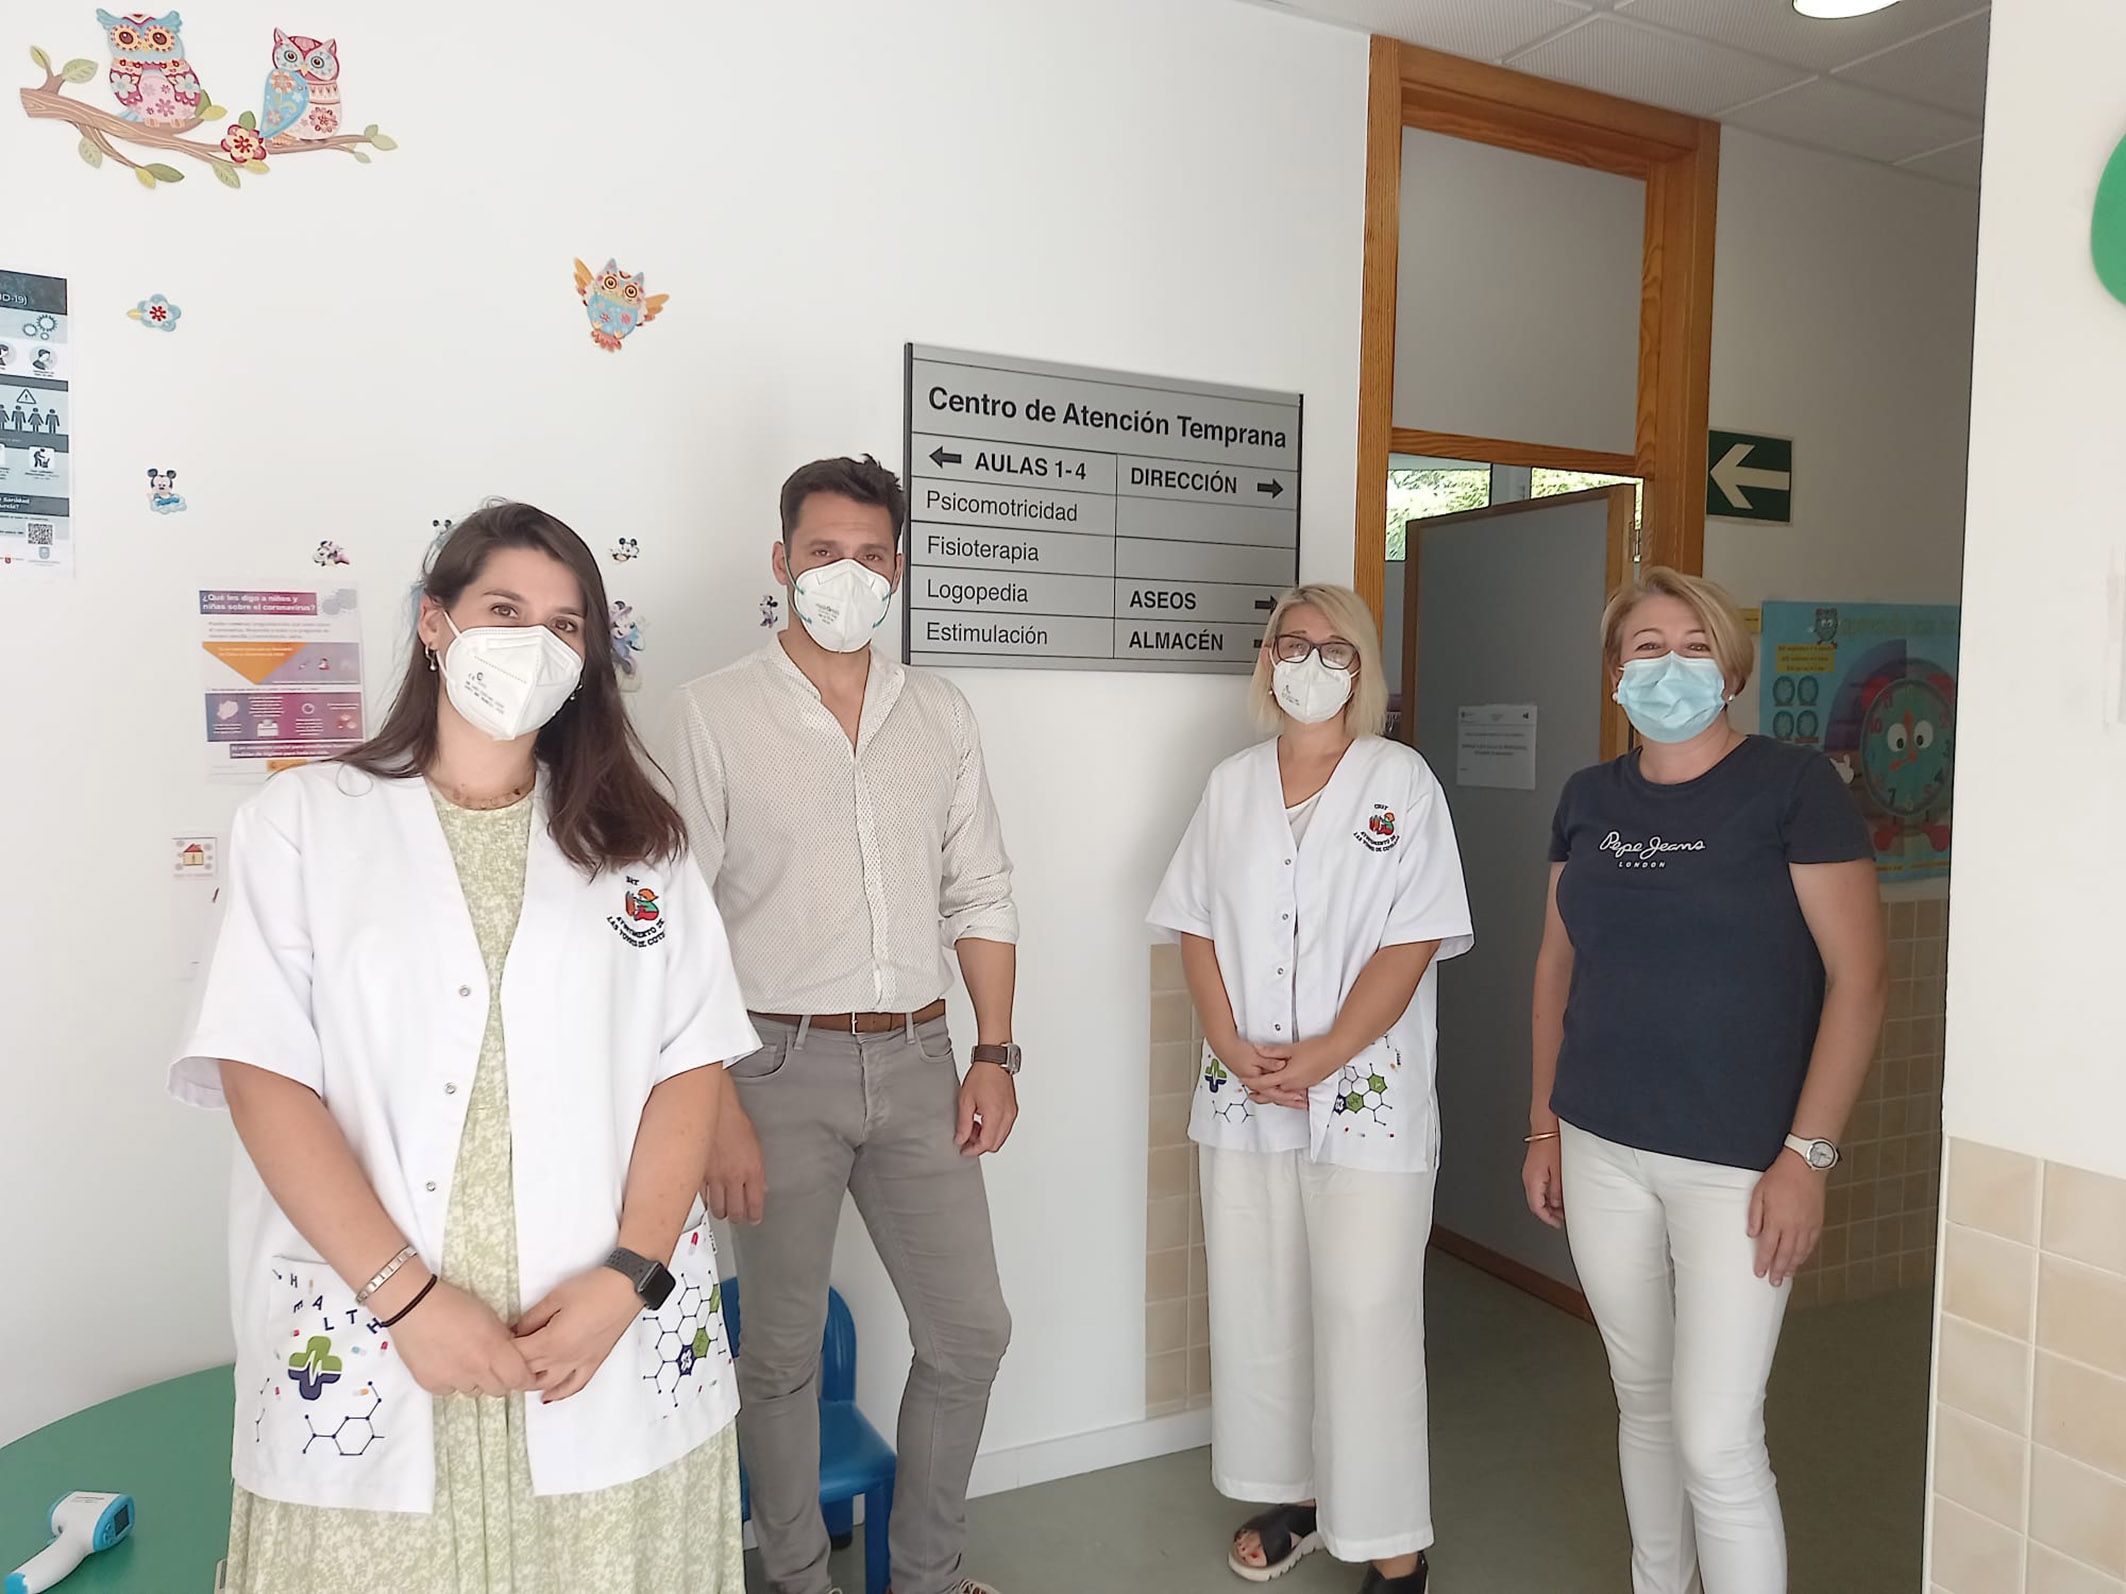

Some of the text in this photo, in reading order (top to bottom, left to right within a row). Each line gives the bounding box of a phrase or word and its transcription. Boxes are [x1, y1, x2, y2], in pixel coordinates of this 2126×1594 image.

[929, 385, 1287, 449] Centro de Atención Temprana
[974, 452, 1087, 481] AULAS 1-4
[1130, 467, 1238, 495] DIRECCIÓN
[926, 490, 1078, 522] Psicomotricidad
[927, 535, 1039, 564] Fisioterapia
[226, 594, 239, 602] les
[241, 594, 259, 603] digo
[293, 596, 299, 604] y
[926, 578, 1029, 605] Logopedia
[1129, 590, 1197, 610] ASEOS
[227, 603, 251, 611] sobre
[253, 603, 262, 611] el
[926, 621, 1048, 645] Estimulación
[1128, 629, 1224, 651] ALMACÉN
[1599, 831, 1706, 860] Pepe Jeans
